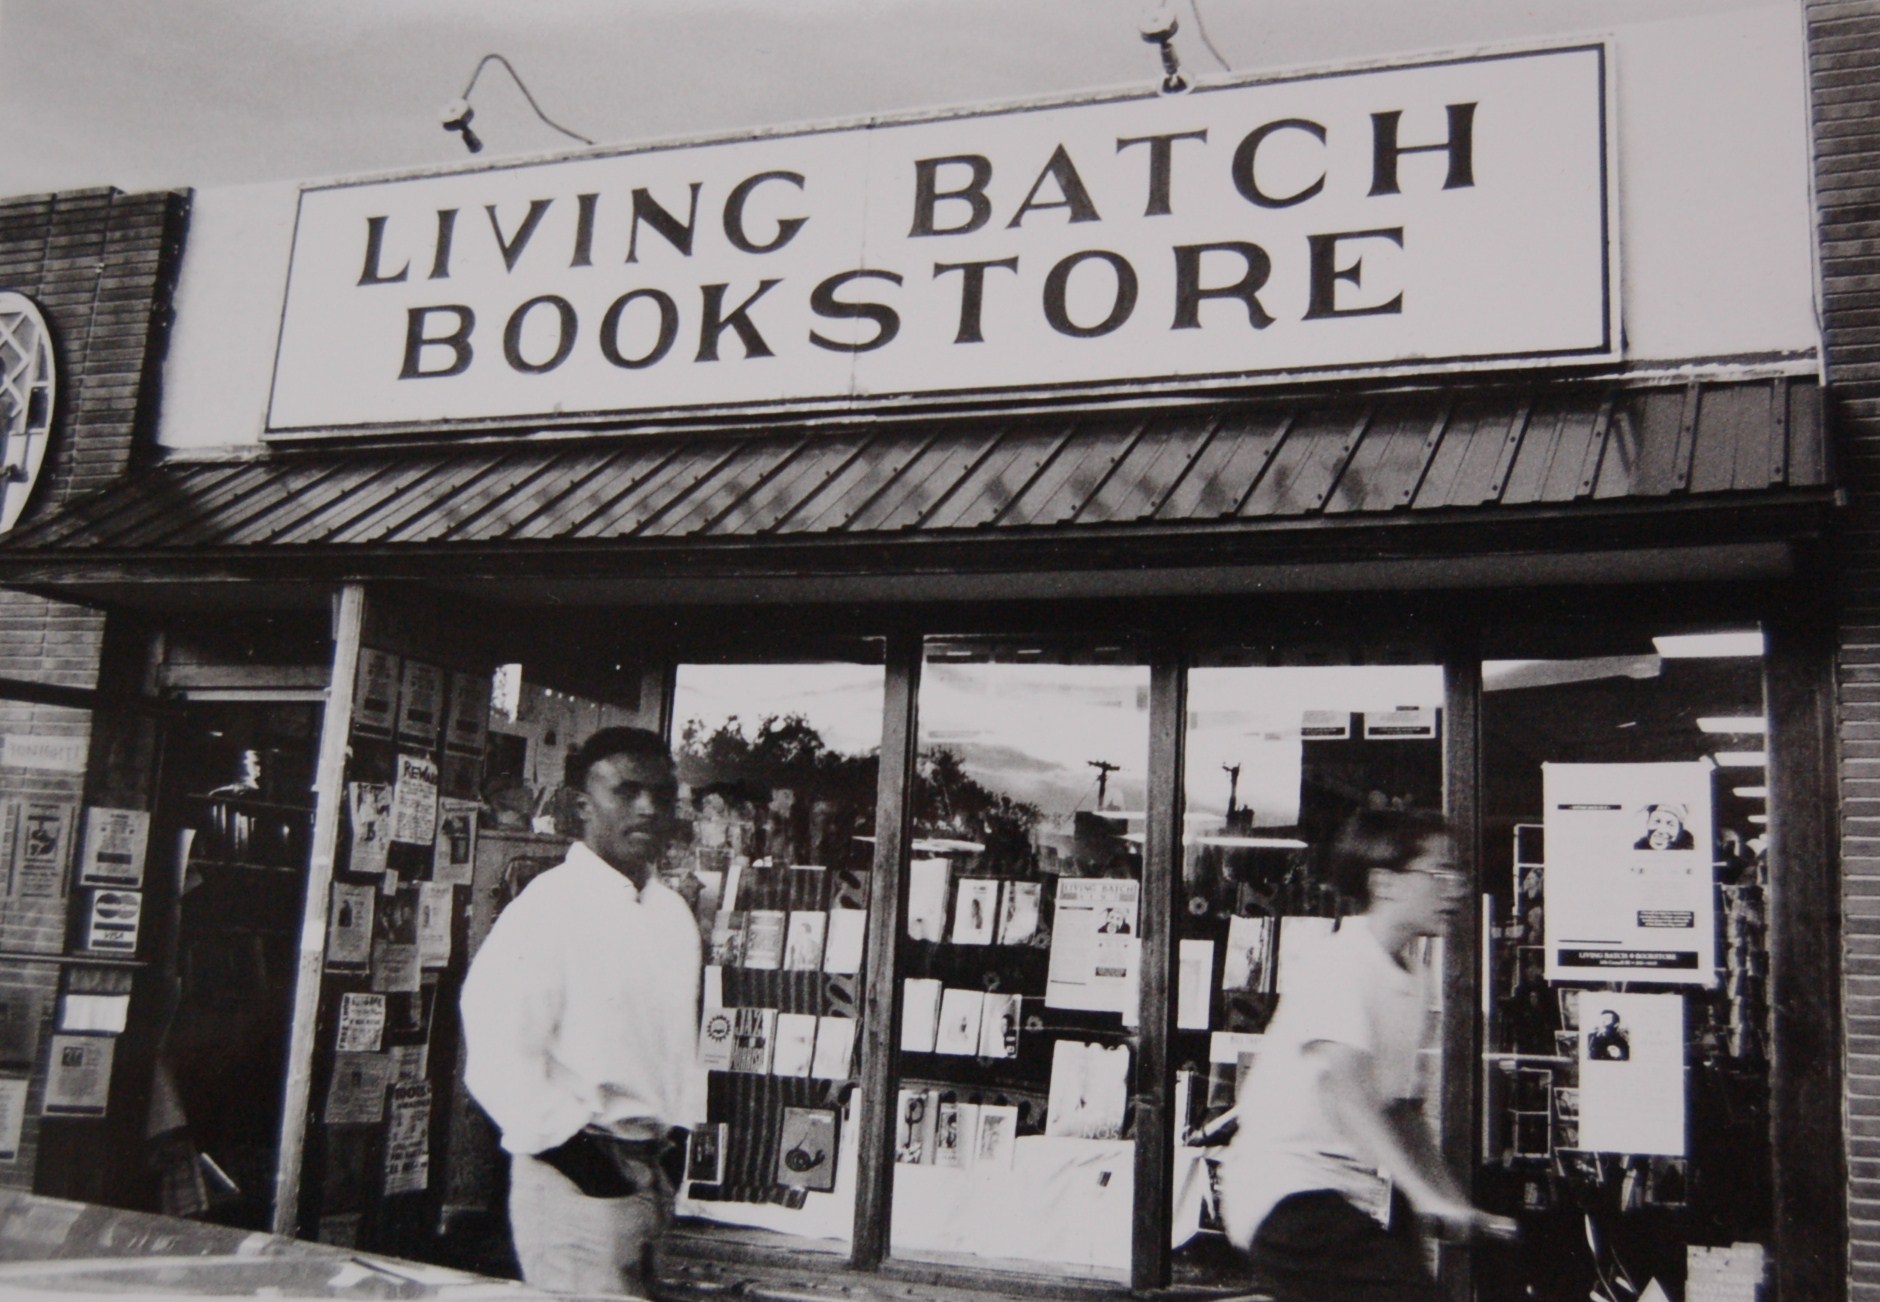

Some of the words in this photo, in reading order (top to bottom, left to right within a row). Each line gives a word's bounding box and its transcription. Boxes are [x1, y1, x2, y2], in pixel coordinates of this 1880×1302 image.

[357, 170, 809, 287] LIVING
[908, 101, 1478, 238] BATCH
[398, 226, 1404, 380] BOOKSTORE
